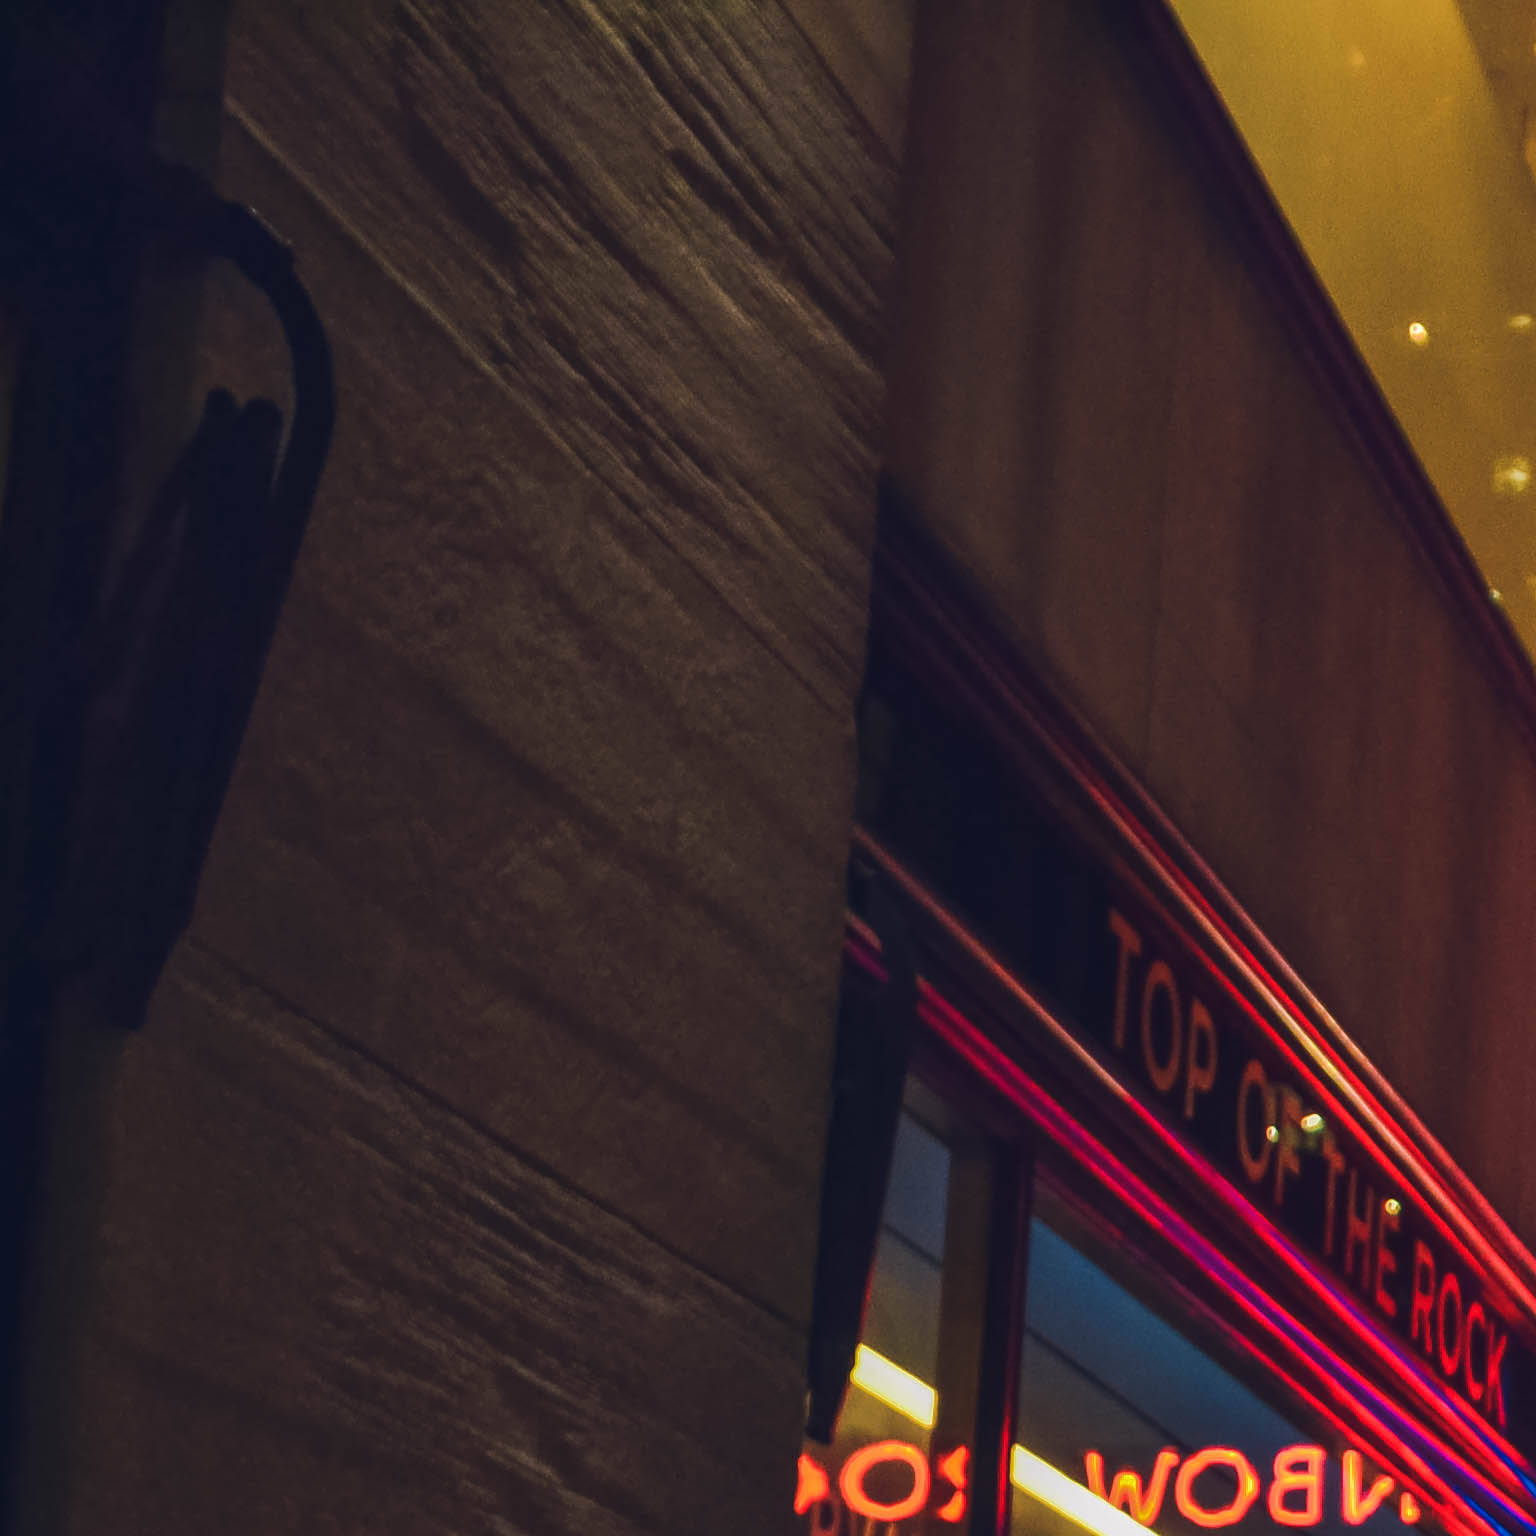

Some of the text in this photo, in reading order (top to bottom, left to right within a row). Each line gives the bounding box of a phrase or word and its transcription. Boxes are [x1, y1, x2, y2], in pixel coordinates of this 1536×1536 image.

[1108, 907, 1507, 1428] TOP OF THE ROCK
